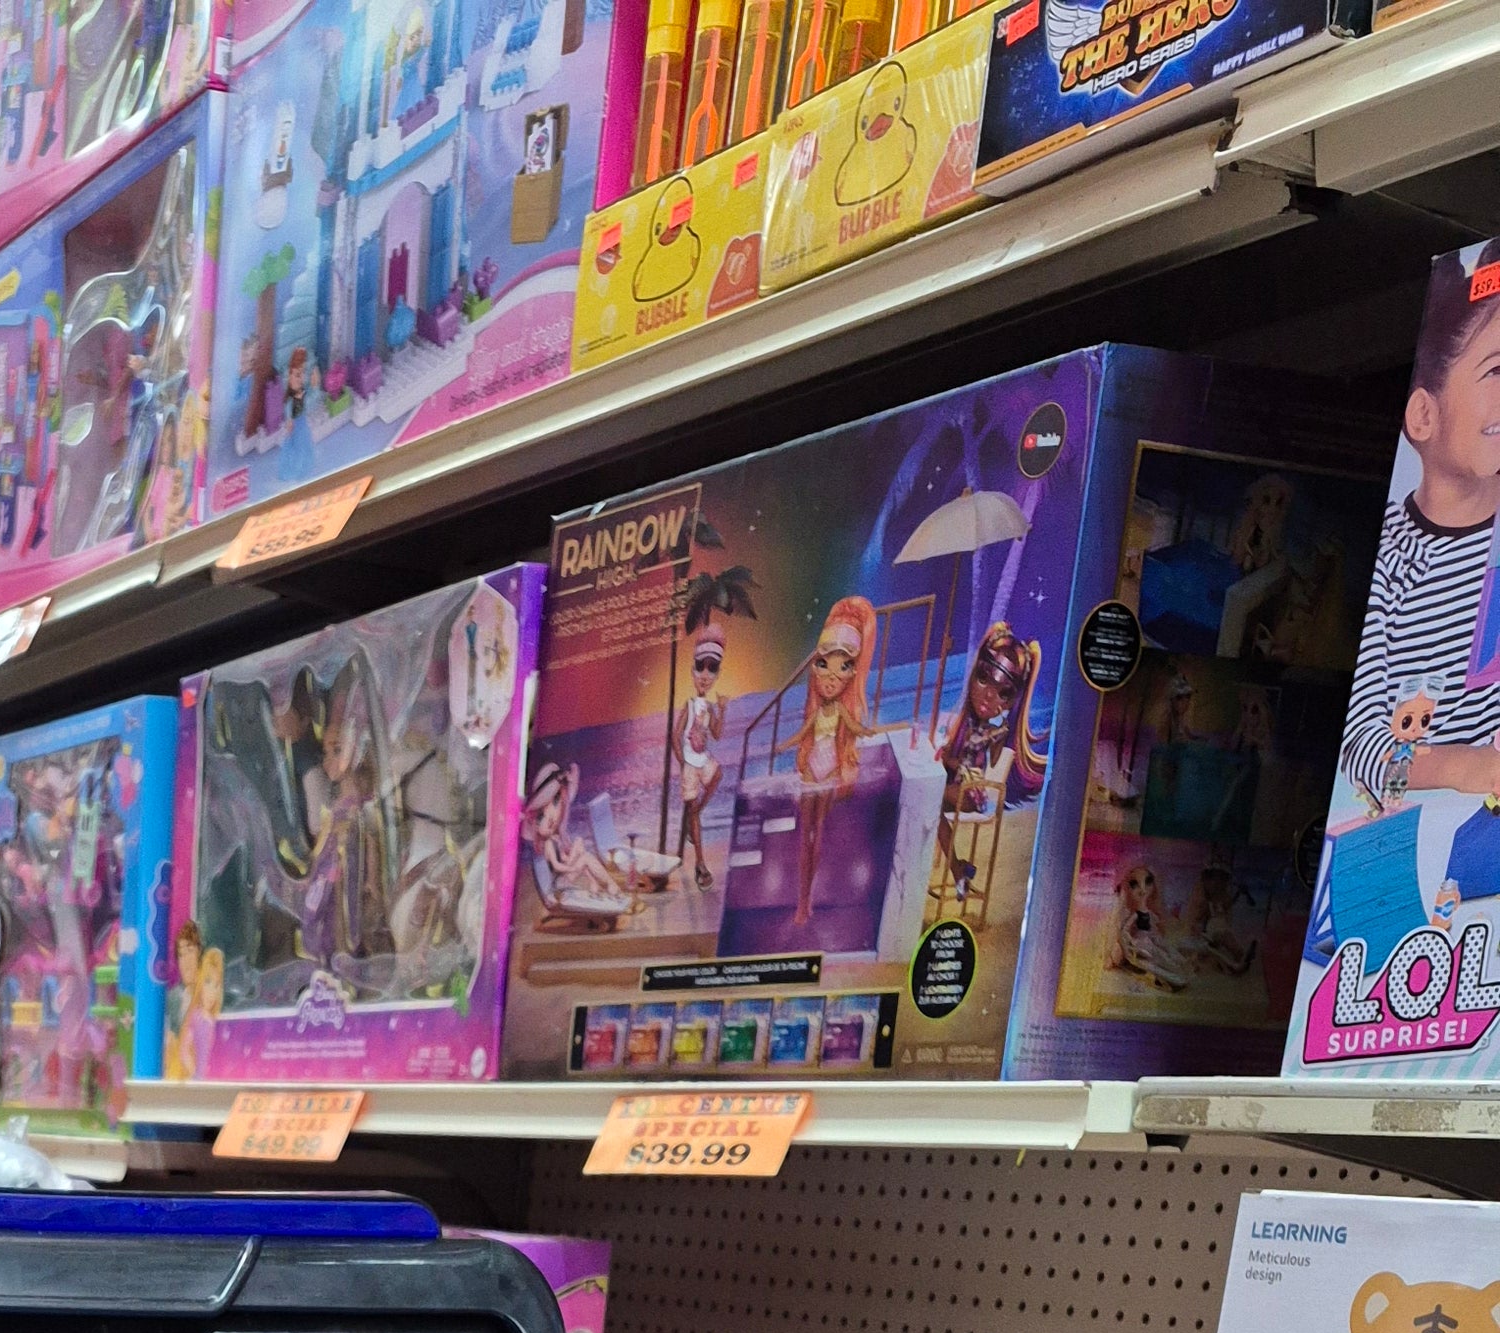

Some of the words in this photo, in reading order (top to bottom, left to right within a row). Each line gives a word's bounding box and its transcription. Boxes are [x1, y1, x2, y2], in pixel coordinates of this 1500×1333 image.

[1062, 24, 1130, 88] THE
[1093, 60, 1137, 93] HERO
[1139, 33, 1196, 71] SERIES
[1211, 51, 1244, 77] HAPPY
[1245, 36, 1277, 62] BUBBLE
[1278, 26, 1304, 48] WAND
[838, 191, 903, 245] BUBBLE
[635, 291, 689, 336] BUBBLE
[560, 505, 687, 578] RAINBOW
[1327, 1019, 1468, 1055] SURPRISE!
[241, 1134, 322, 1155] $49.99
[633, 1120, 761, 1137] SPECIAL
[626, 1141, 751, 1167] $39.99
[1251, 1221, 1347, 1244] LEARNING
[1245, 1266, 1282, 1285] design
[1248, 1249, 1311, 1267] Meticulous
